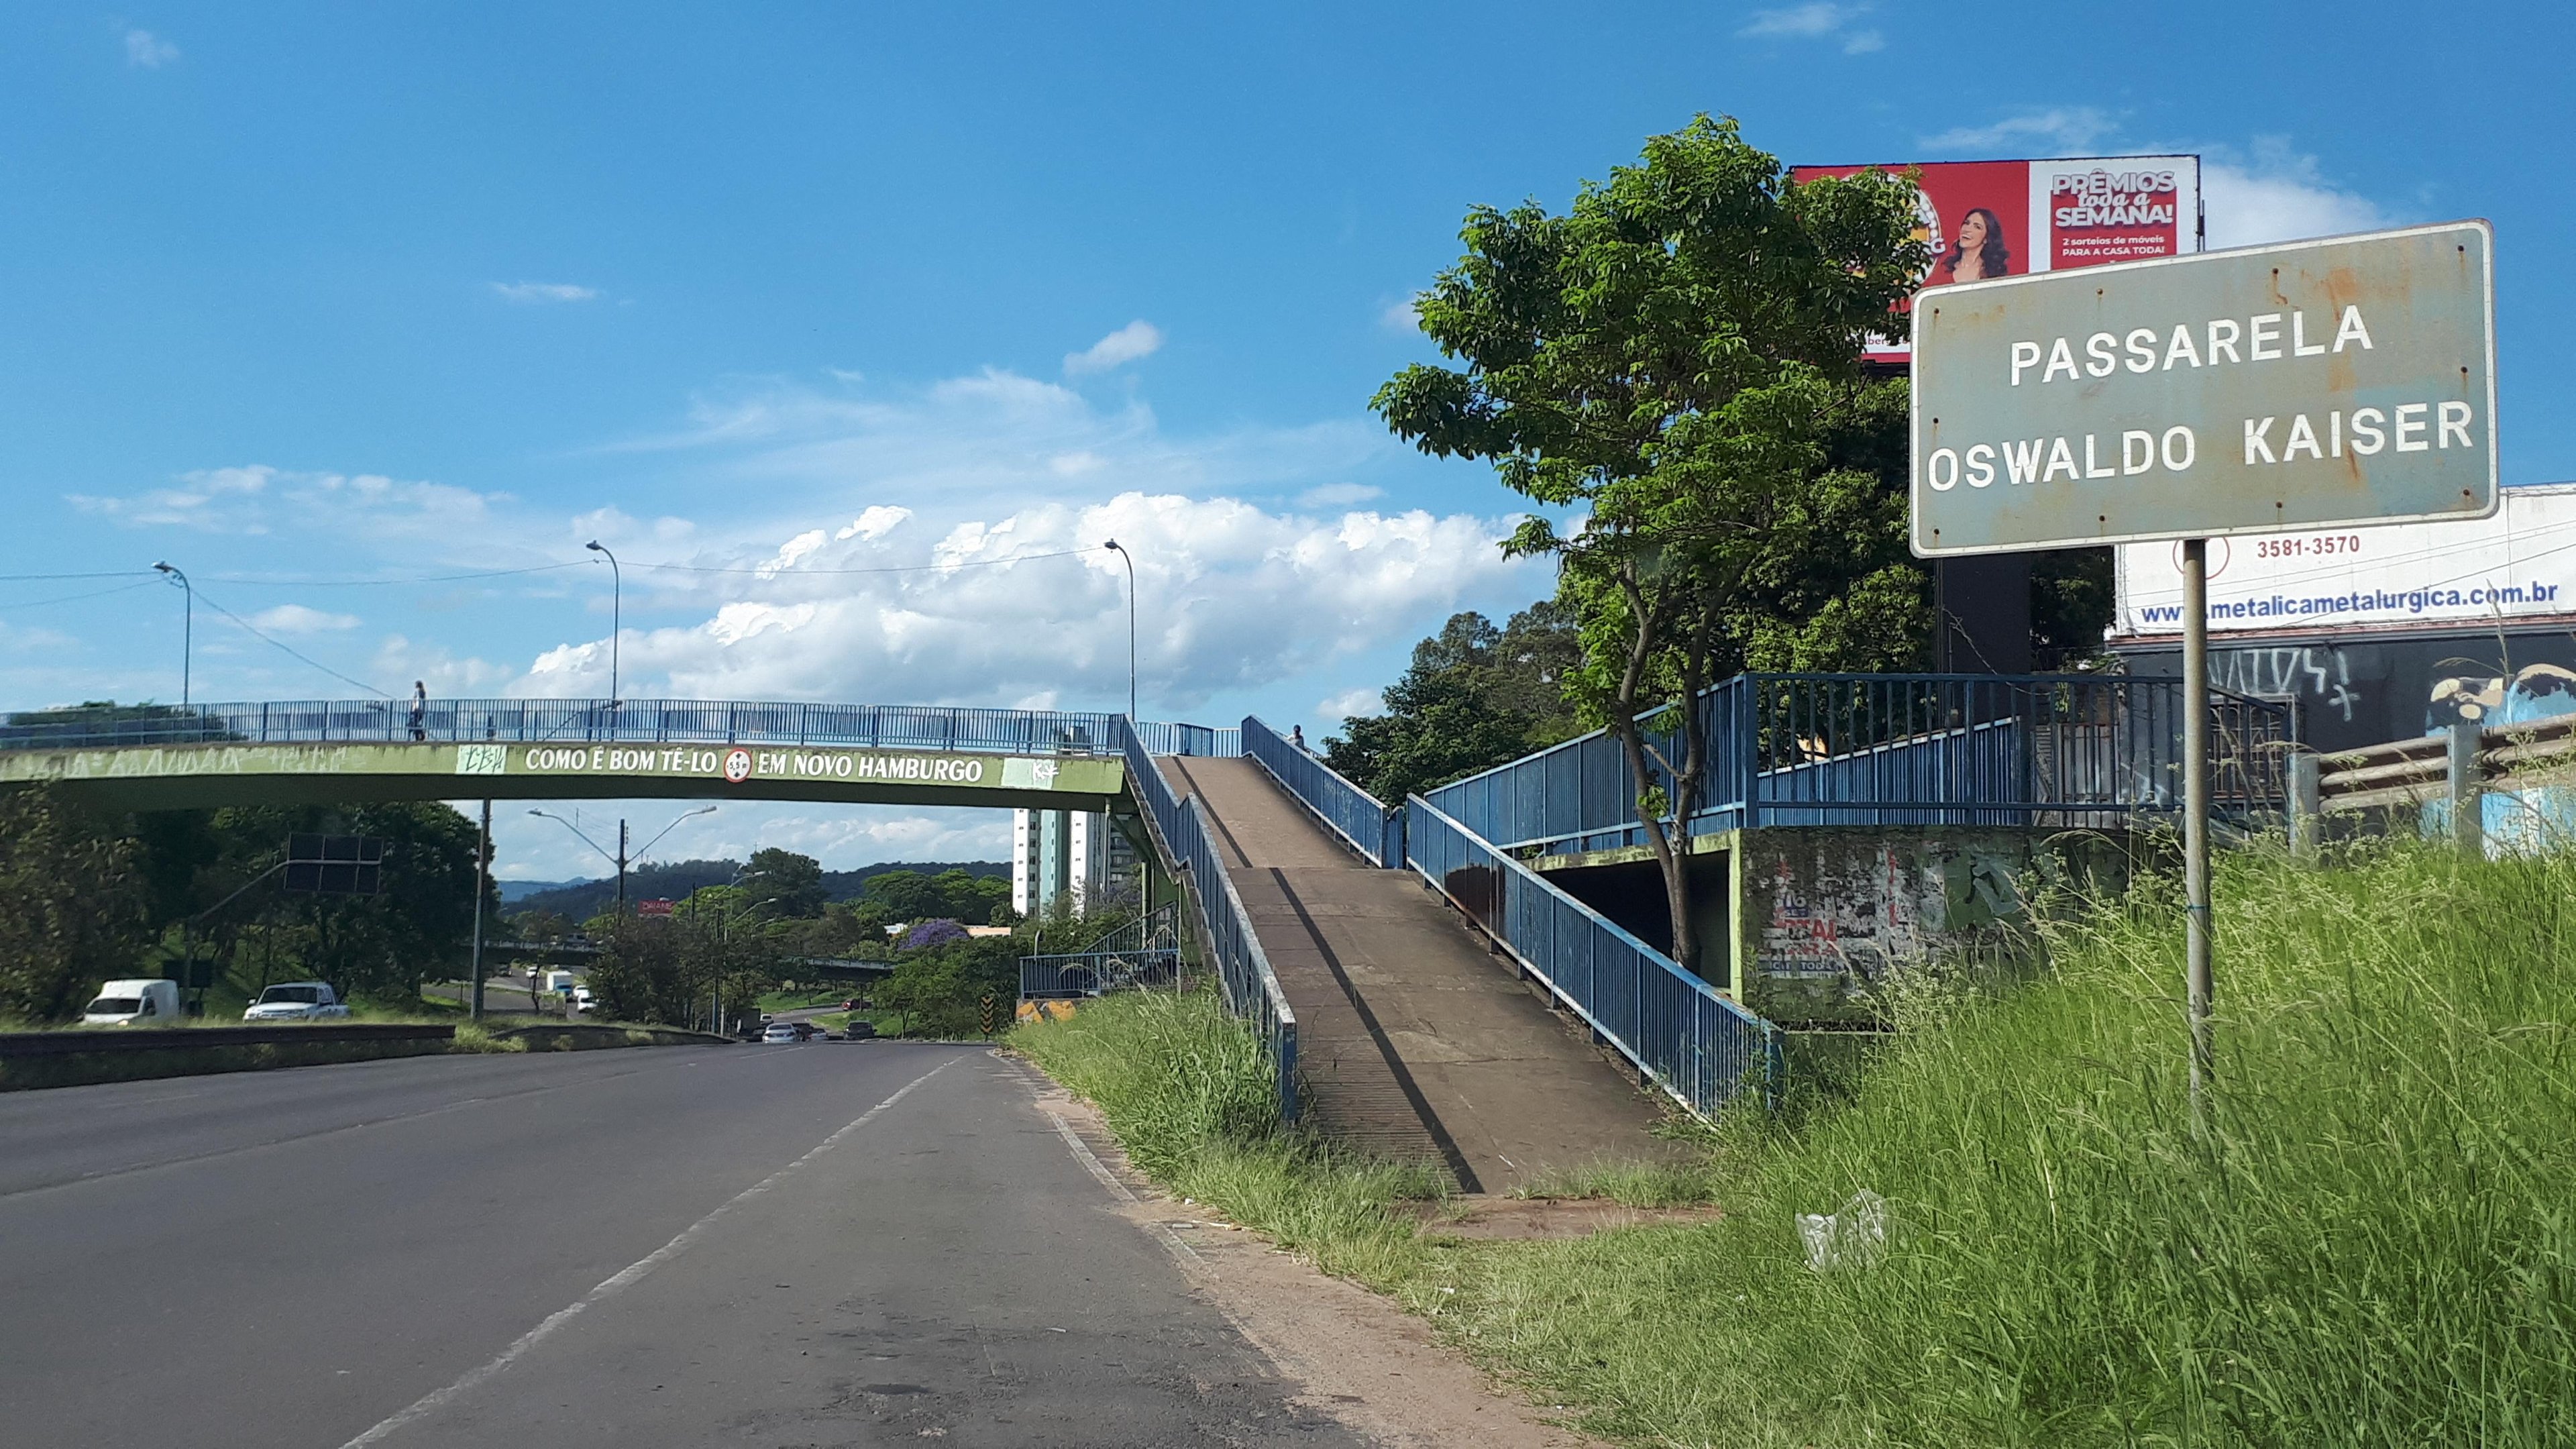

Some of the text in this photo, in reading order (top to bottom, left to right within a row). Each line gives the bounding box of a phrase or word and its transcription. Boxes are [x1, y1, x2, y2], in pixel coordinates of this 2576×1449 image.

[2052, 168, 2176, 195] PRÊMIOS
[2078, 189, 2151, 207] toda a
[2055, 205, 2174, 227] SEMANA!
[2062, 246, 2165, 256] PARA A CASA TODA!
[2071, 237, 2111, 246] sorteios
[2112, 236, 2126, 245] de
[2129, 235, 2165, 244] móveis
[2011, 305, 2373, 386] PASSARELA
[1927, 400, 2473, 492] OSWALDO KAISER
[2257, 535, 2360, 558] 3581-3570
[2141, 580, 2559, 623] ww.metalicametalurgica.com.br
[525, 746, 983, 782] COMO É BOM TÊ-LO EM NOVO HAMBURGO
